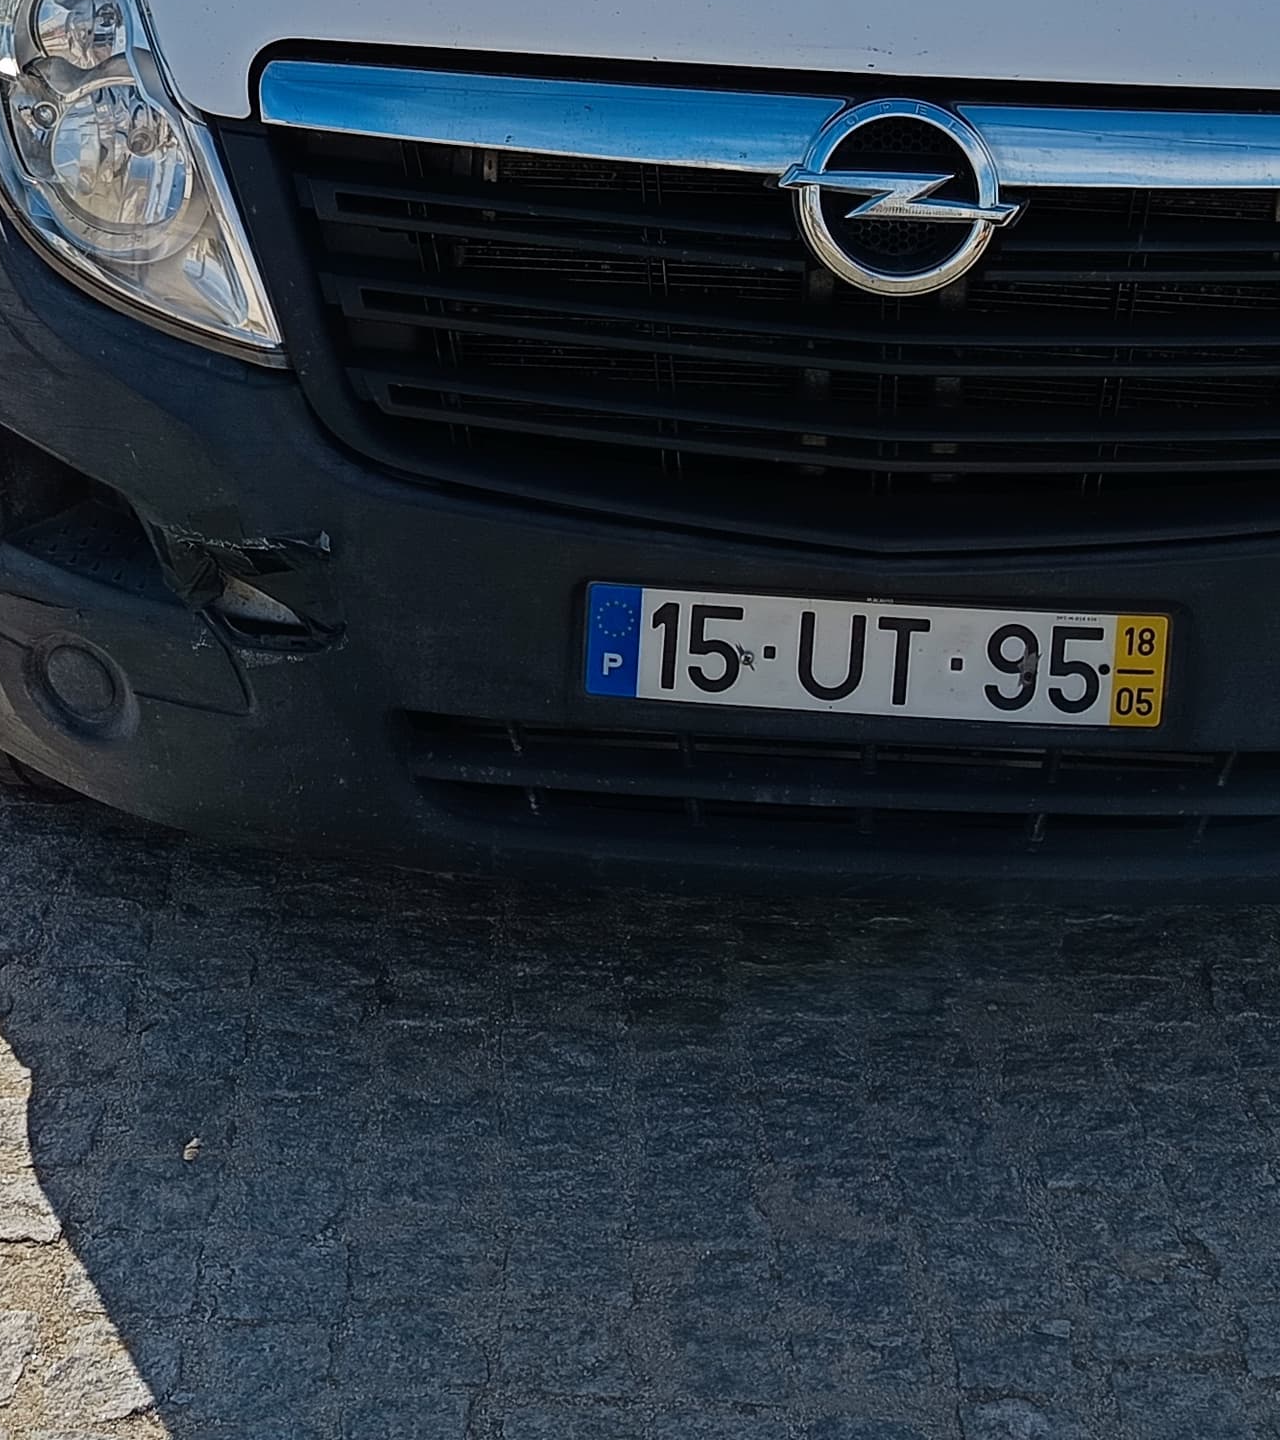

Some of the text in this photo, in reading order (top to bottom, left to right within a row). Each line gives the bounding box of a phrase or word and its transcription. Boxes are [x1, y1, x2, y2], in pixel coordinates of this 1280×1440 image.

[844, 101, 965, 133] OPEL
[1124, 626, 1156, 657] 18
[602, 651, 623, 676] P
[1115, 686, 1154, 717] 05
